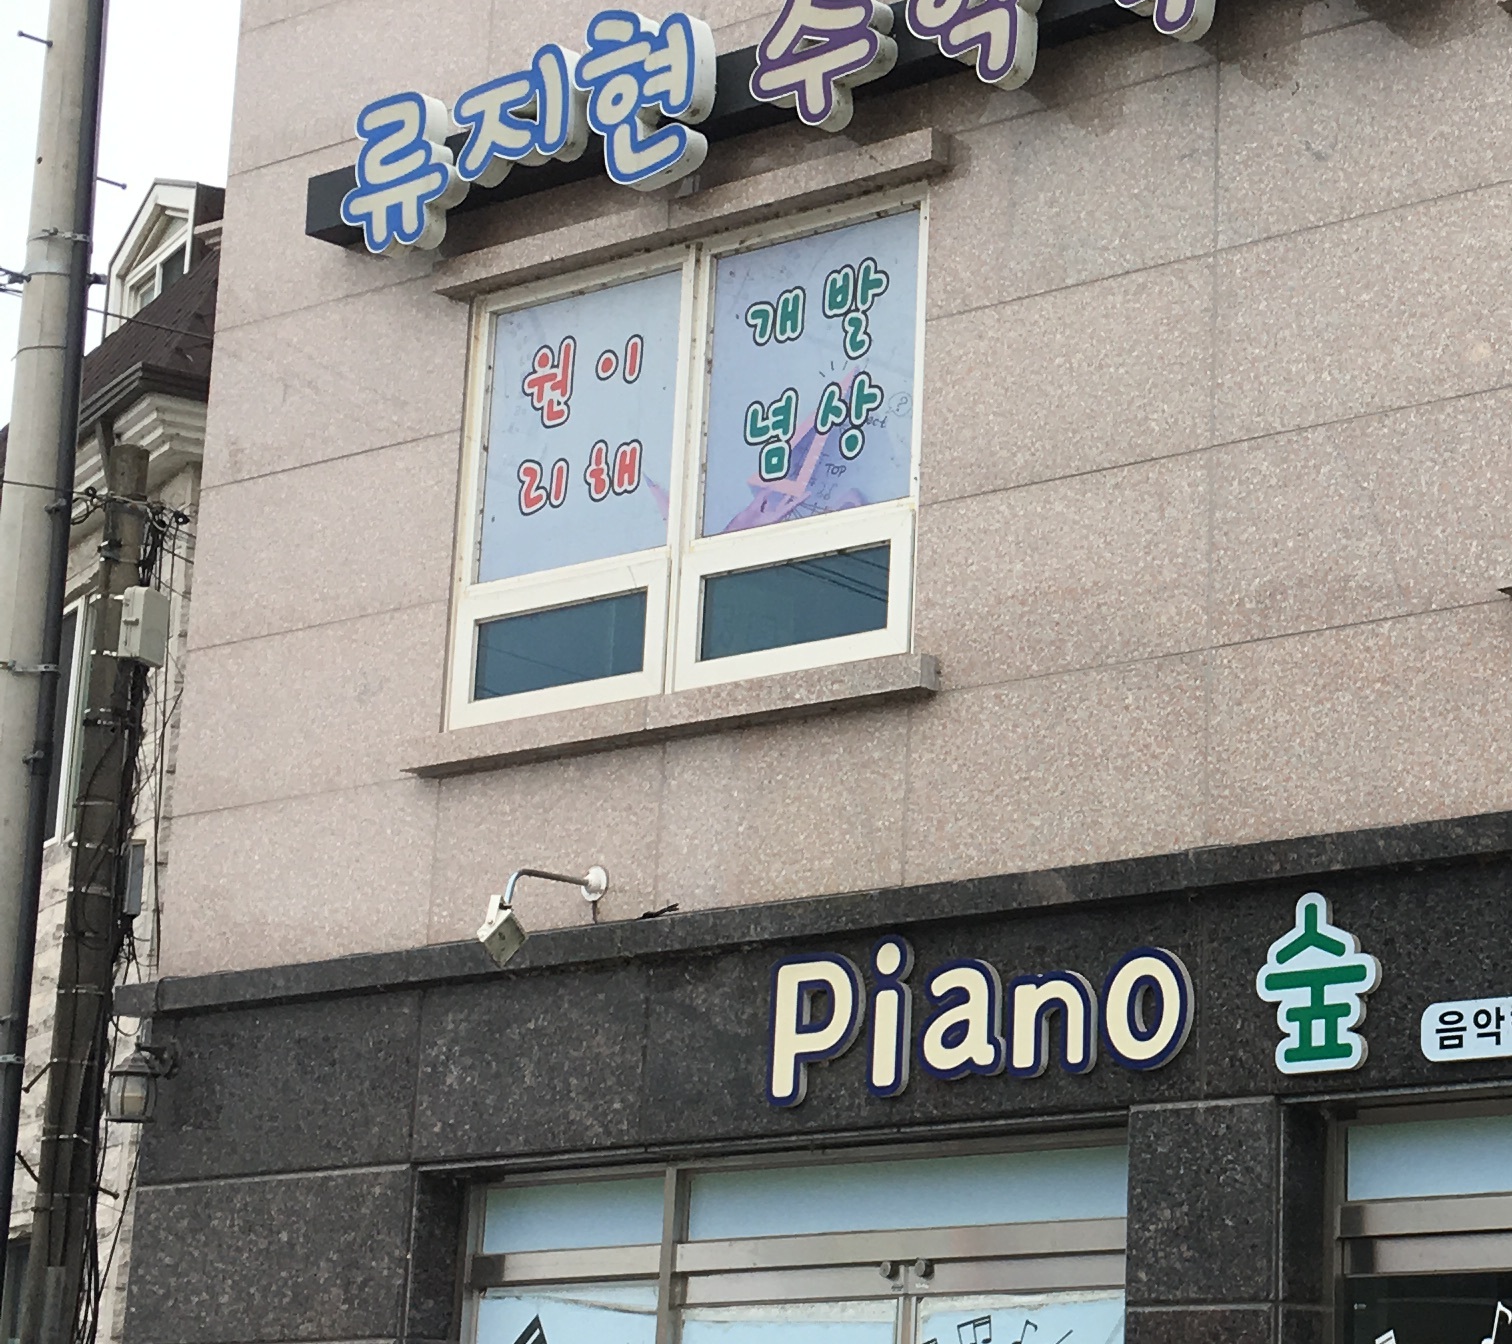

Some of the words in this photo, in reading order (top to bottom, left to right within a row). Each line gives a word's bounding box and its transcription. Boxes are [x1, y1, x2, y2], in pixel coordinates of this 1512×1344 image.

[341, 9, 713, 253] 류지현
[767, 935, 1195, 1106] Piano
[1256, 892, 1381, 1074] 숲
